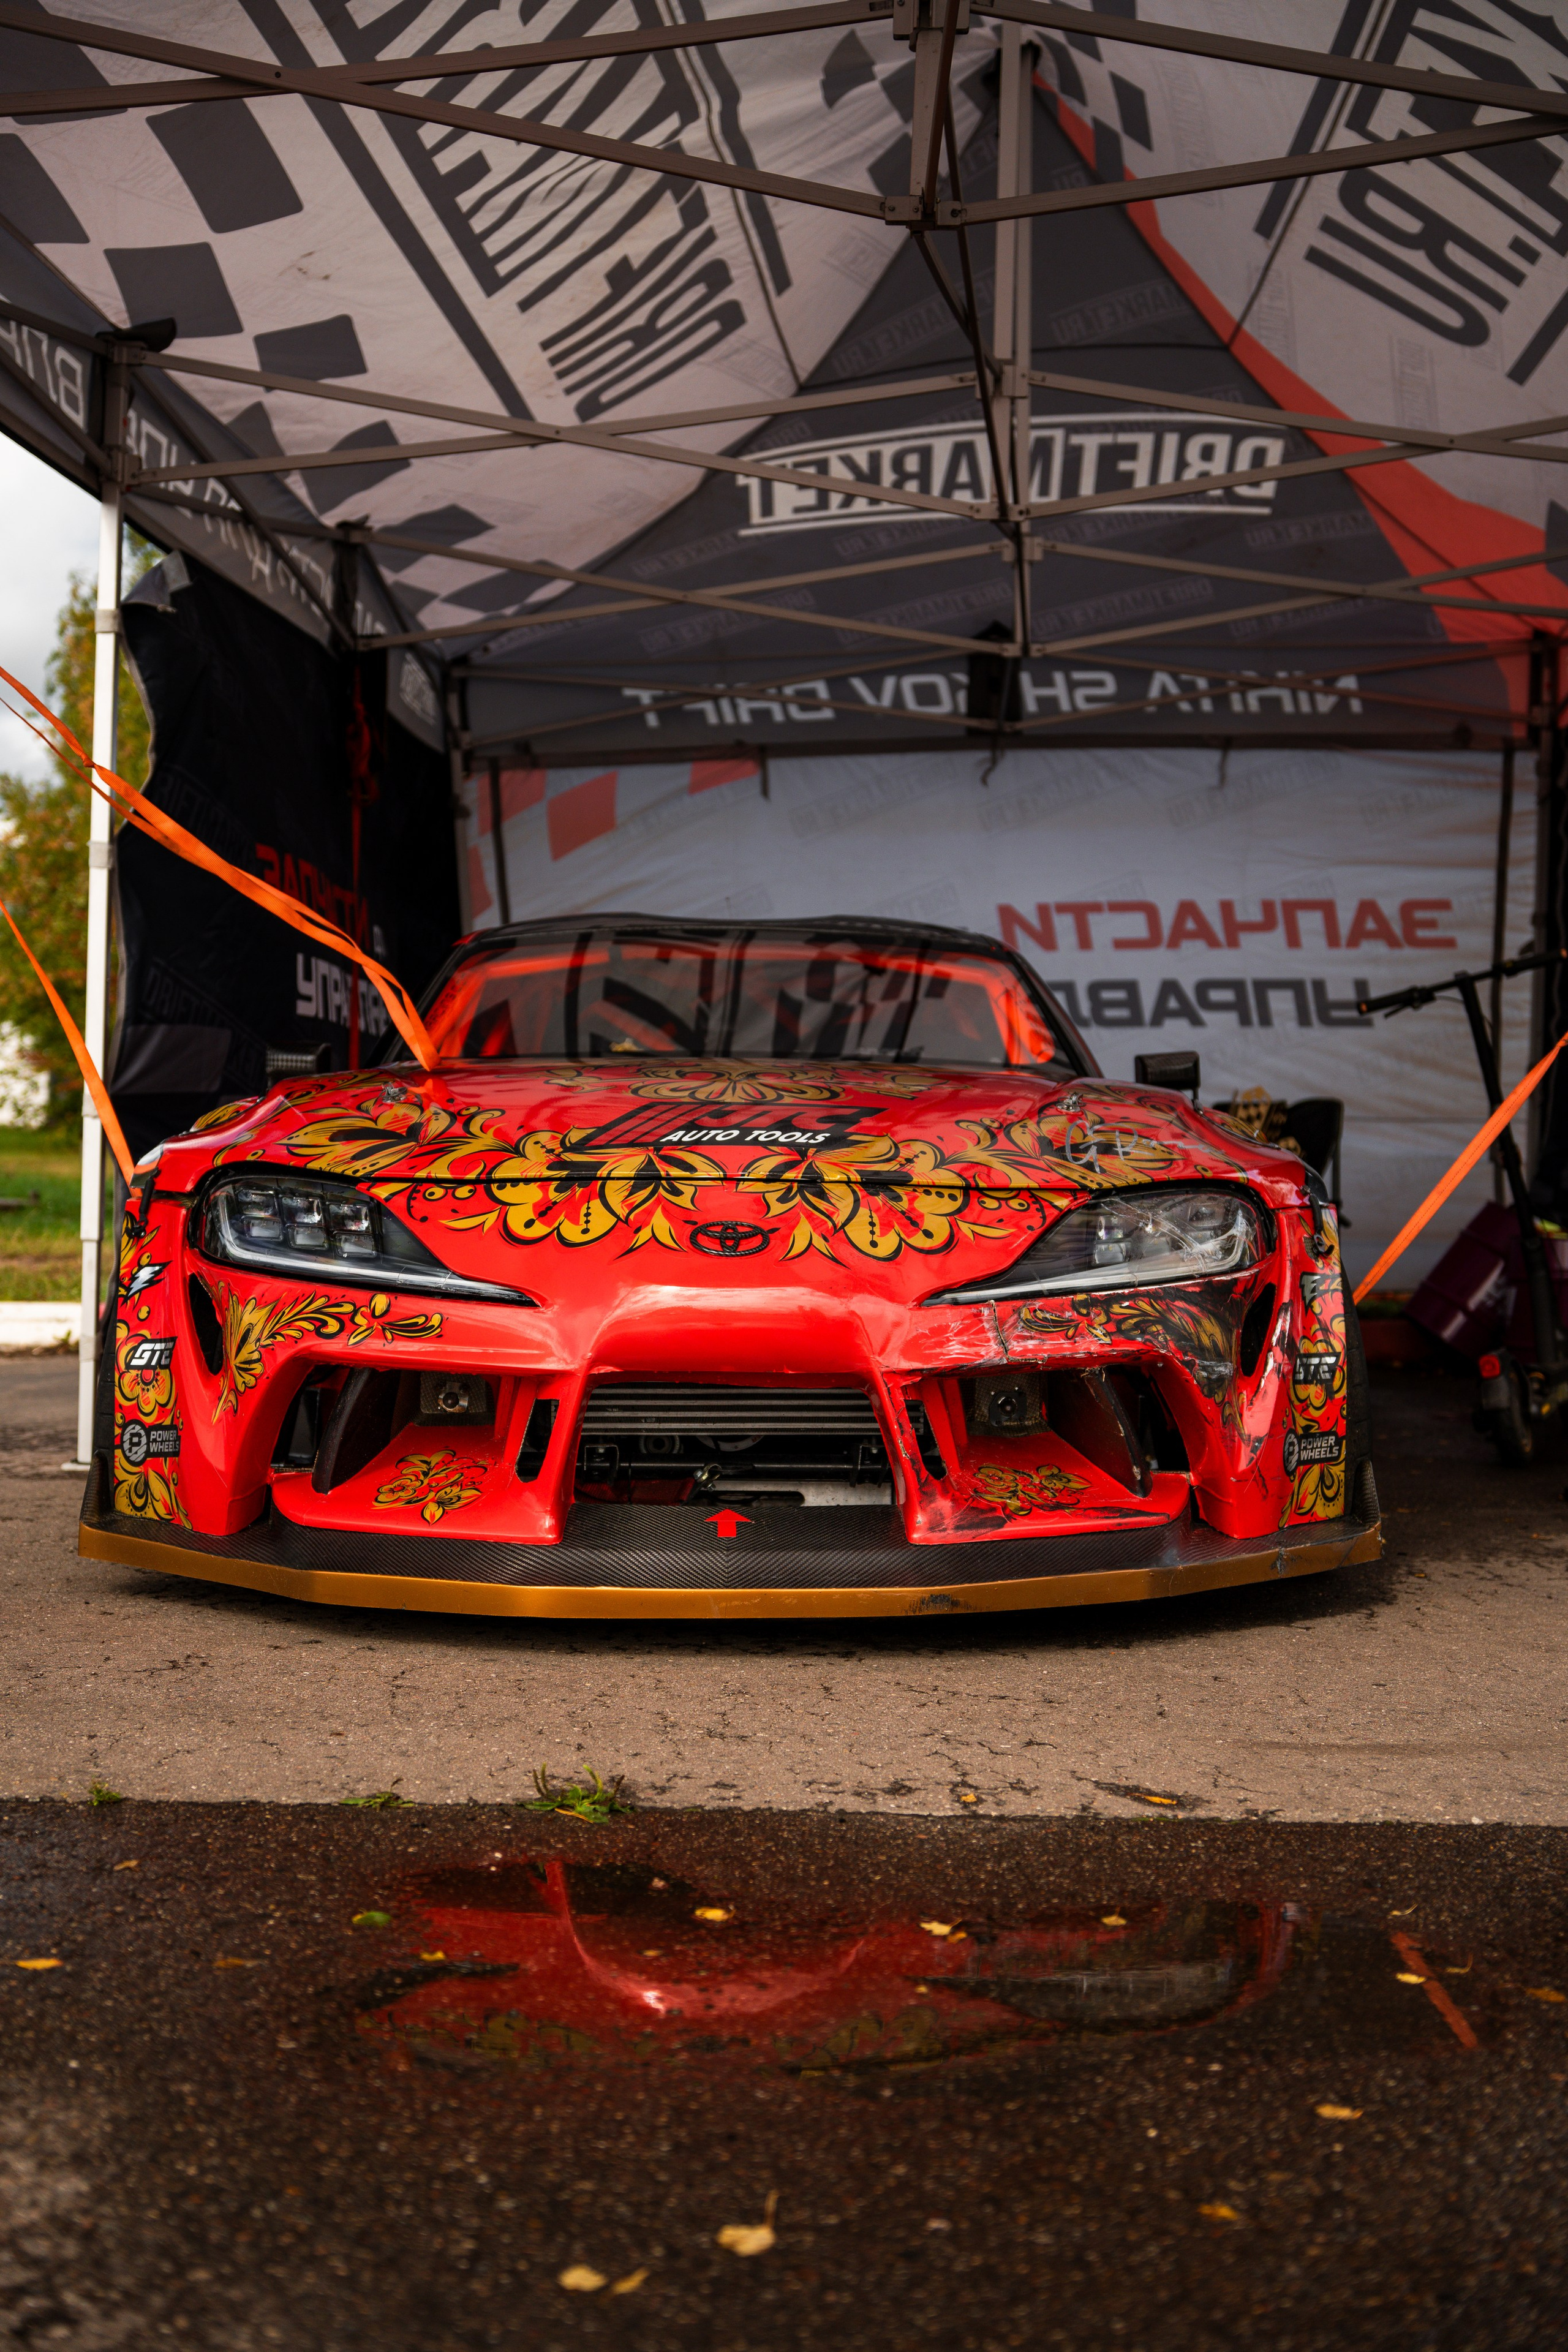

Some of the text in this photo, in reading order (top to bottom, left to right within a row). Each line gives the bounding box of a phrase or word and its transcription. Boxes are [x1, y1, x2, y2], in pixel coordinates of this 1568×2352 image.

[659, 1129, 832, 1144] AUTO TOOLS
[150, 1430, 178, 1442] POWER
[1301, 1436, 1336, 1450] POWER
[149, 1441, 179, 1453] WHEELS
[1300, 1446, 1340, 1461] WHEELS
